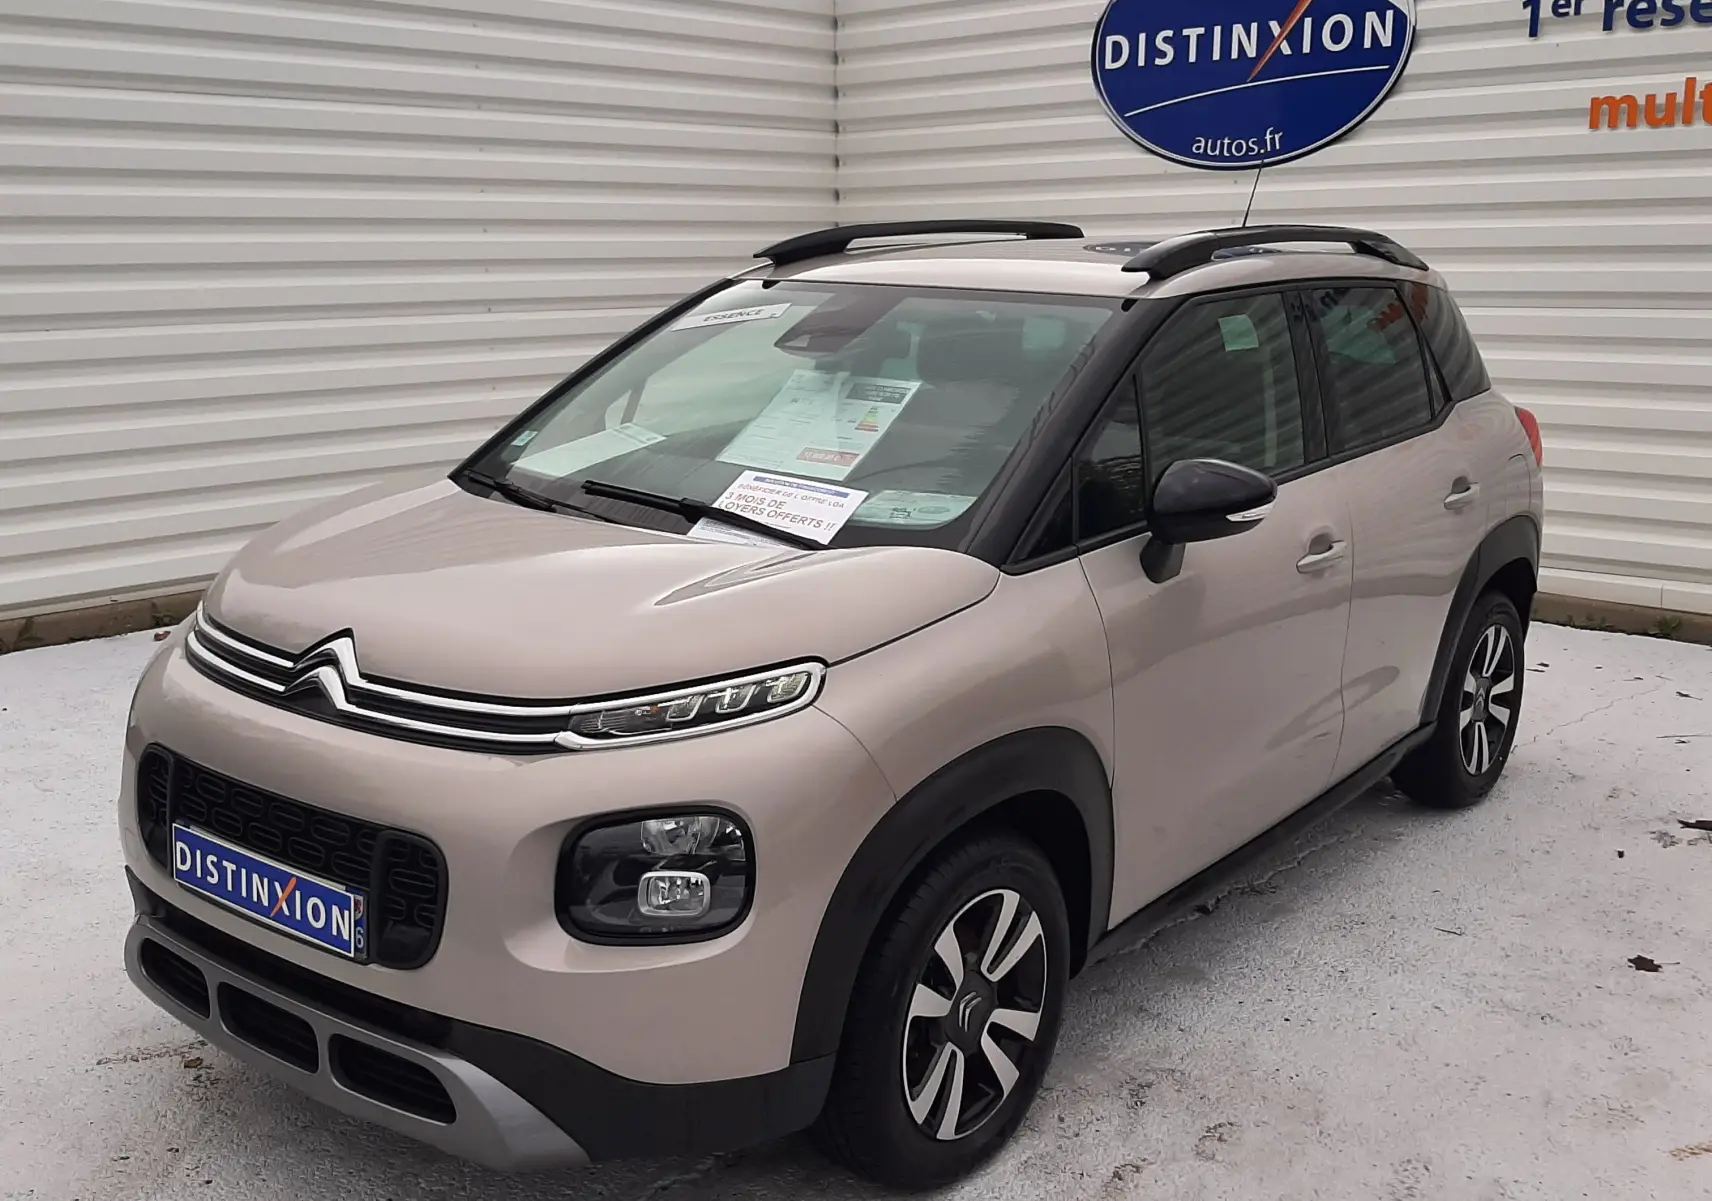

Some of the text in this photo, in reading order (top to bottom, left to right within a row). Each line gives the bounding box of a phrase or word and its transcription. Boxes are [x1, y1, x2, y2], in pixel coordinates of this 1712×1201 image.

[1104, 6, 1395, 70] DISTINXION
[1191, 127, 1284, 156] autos.fr
[725, 491, 787, 510] 3 MOIS DE
[766, 510, 824, 529] OFFERTS
[175, 841, 351, 941] DISTINXION
